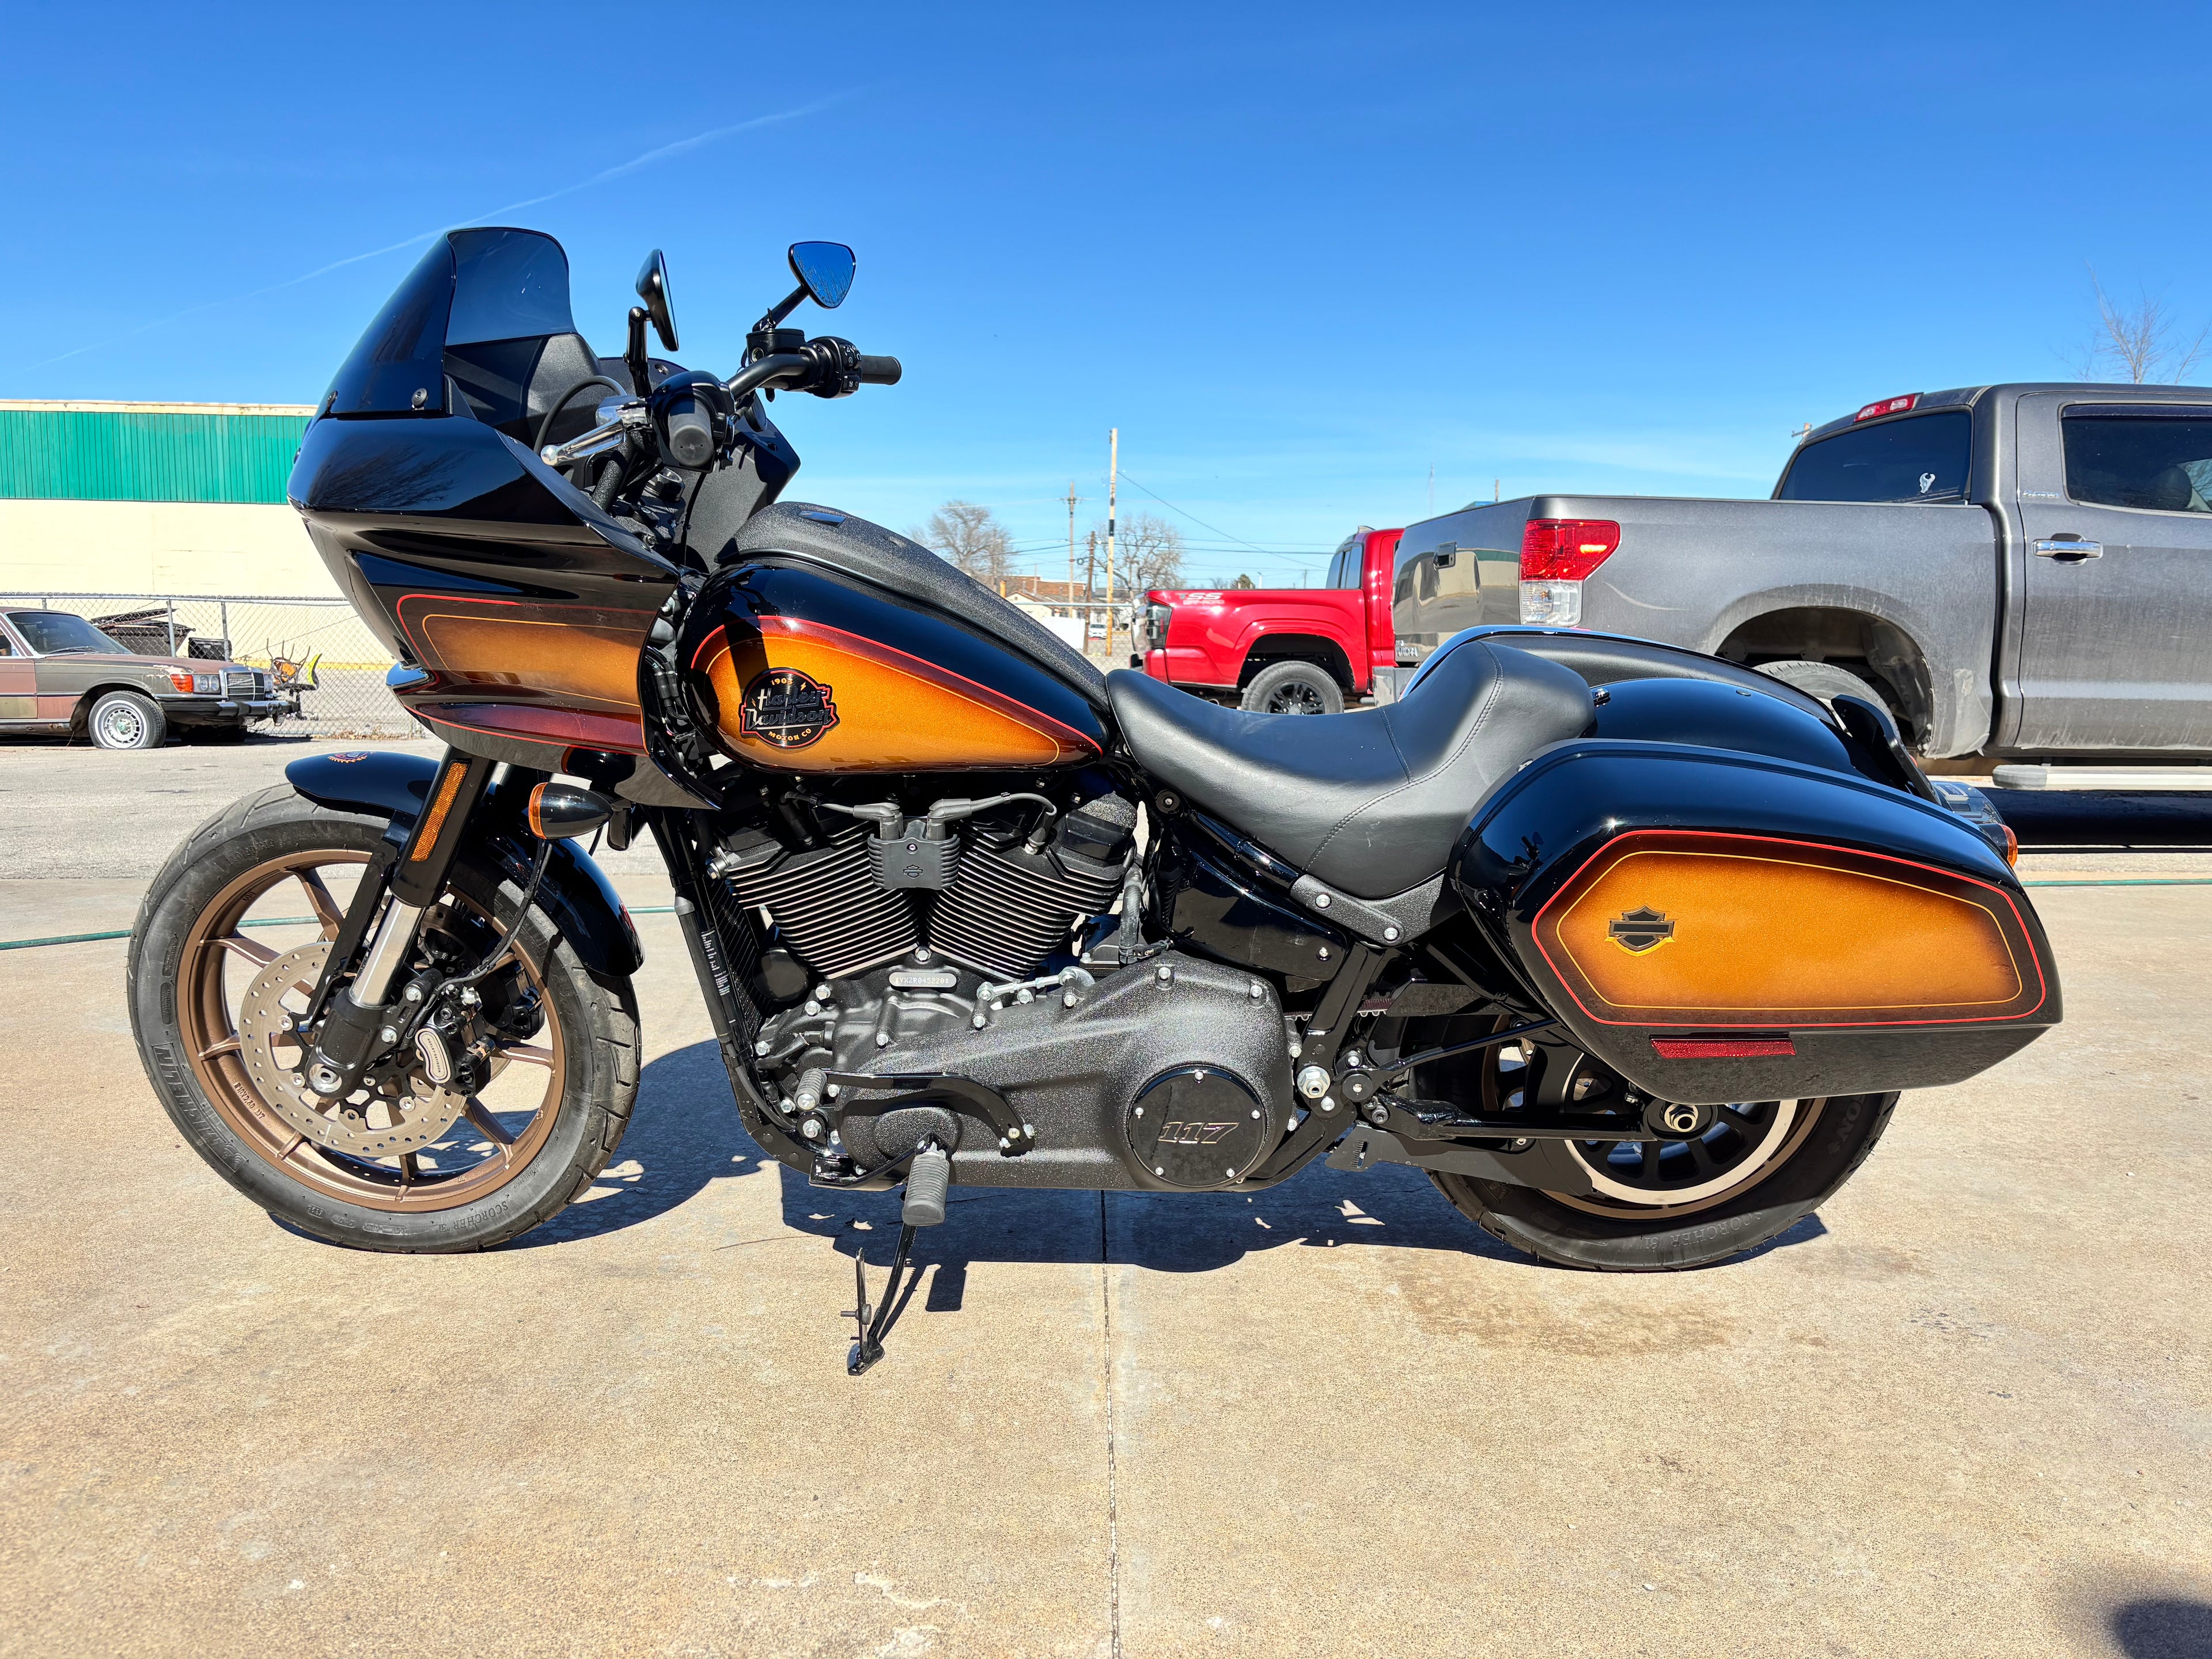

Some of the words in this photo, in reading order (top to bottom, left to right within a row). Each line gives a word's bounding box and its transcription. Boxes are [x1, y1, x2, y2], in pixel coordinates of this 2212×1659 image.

[771, 677, 793, 685] 1903
[768, 731, 800, 741] MOTOR
[801, 728, 812, 737] CO
[154, 1047, 223, 1146] MICHELIN
[1158, 1121, 1240, 1144] 117
[453, 1200, 508, 1230] SCORCHER
[1671, 1212, 1763, 1248] SCORCHER
